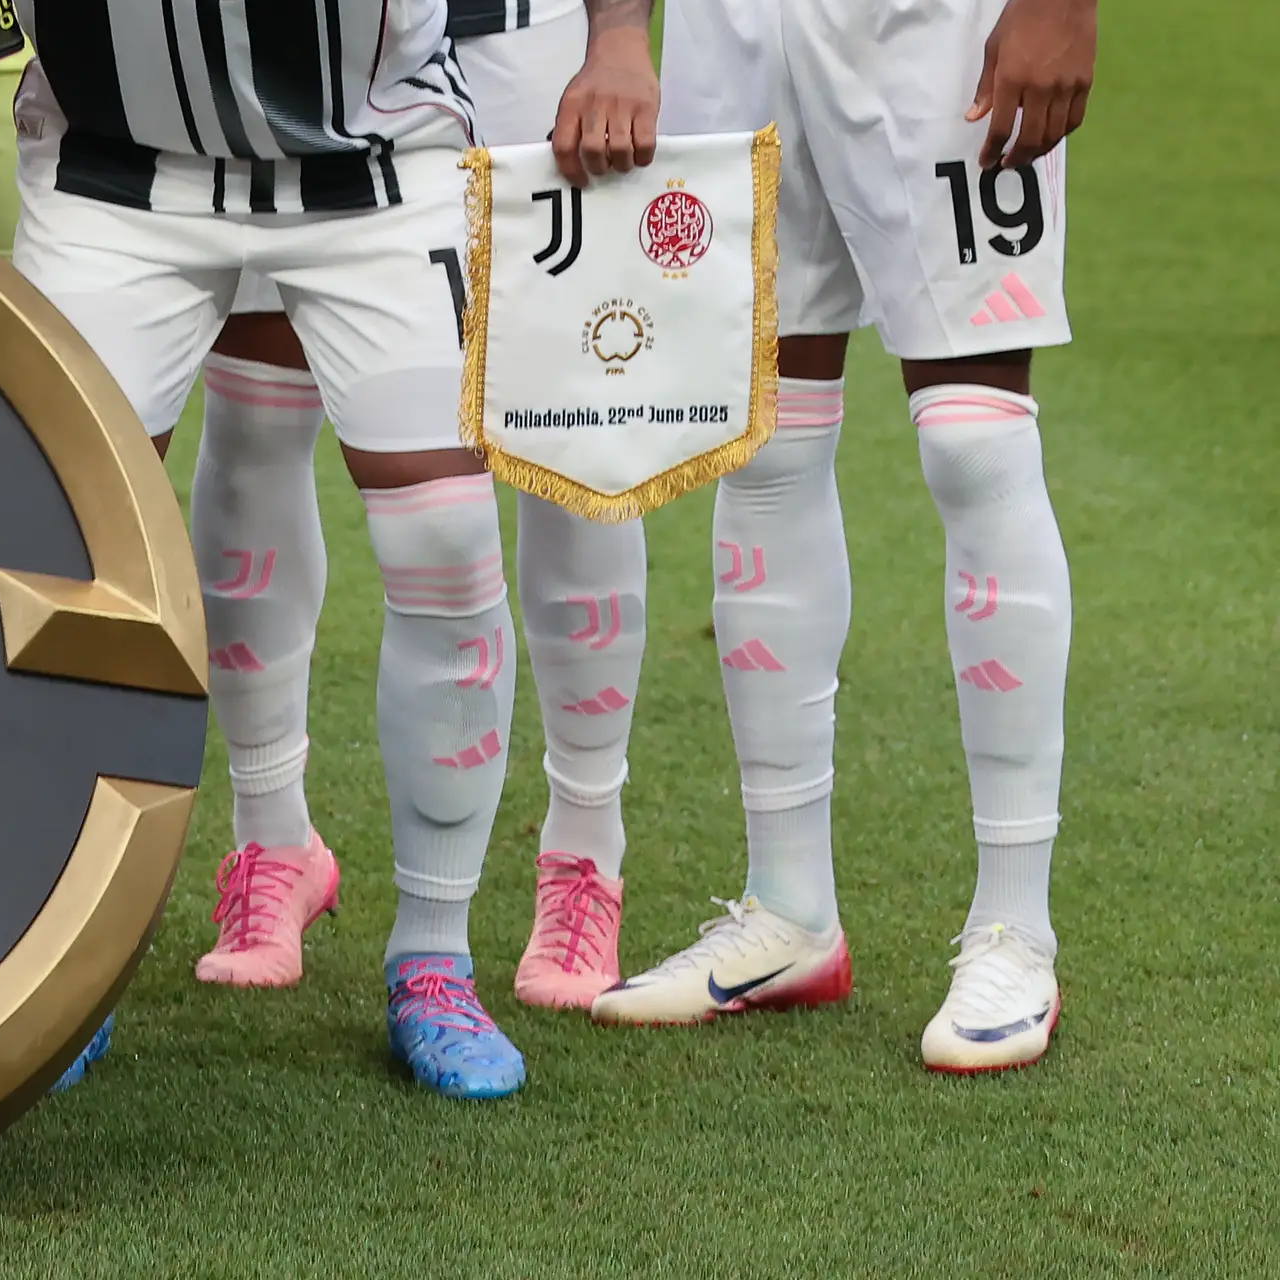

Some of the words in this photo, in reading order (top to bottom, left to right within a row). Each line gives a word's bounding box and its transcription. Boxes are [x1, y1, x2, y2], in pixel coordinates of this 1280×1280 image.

[934, 158, 1044, 265] 19
[592, 297, 633, 317] WORLD
[637, 307, 654, 329] CUP
[605, 366, 626, 376] FIFA
[504, 407, 604, 430] Philadelphia,
[608, 404, 644, 425] 22nd
[648, 404, 685, 424] June
[689, 404, 729, 424] 2025
